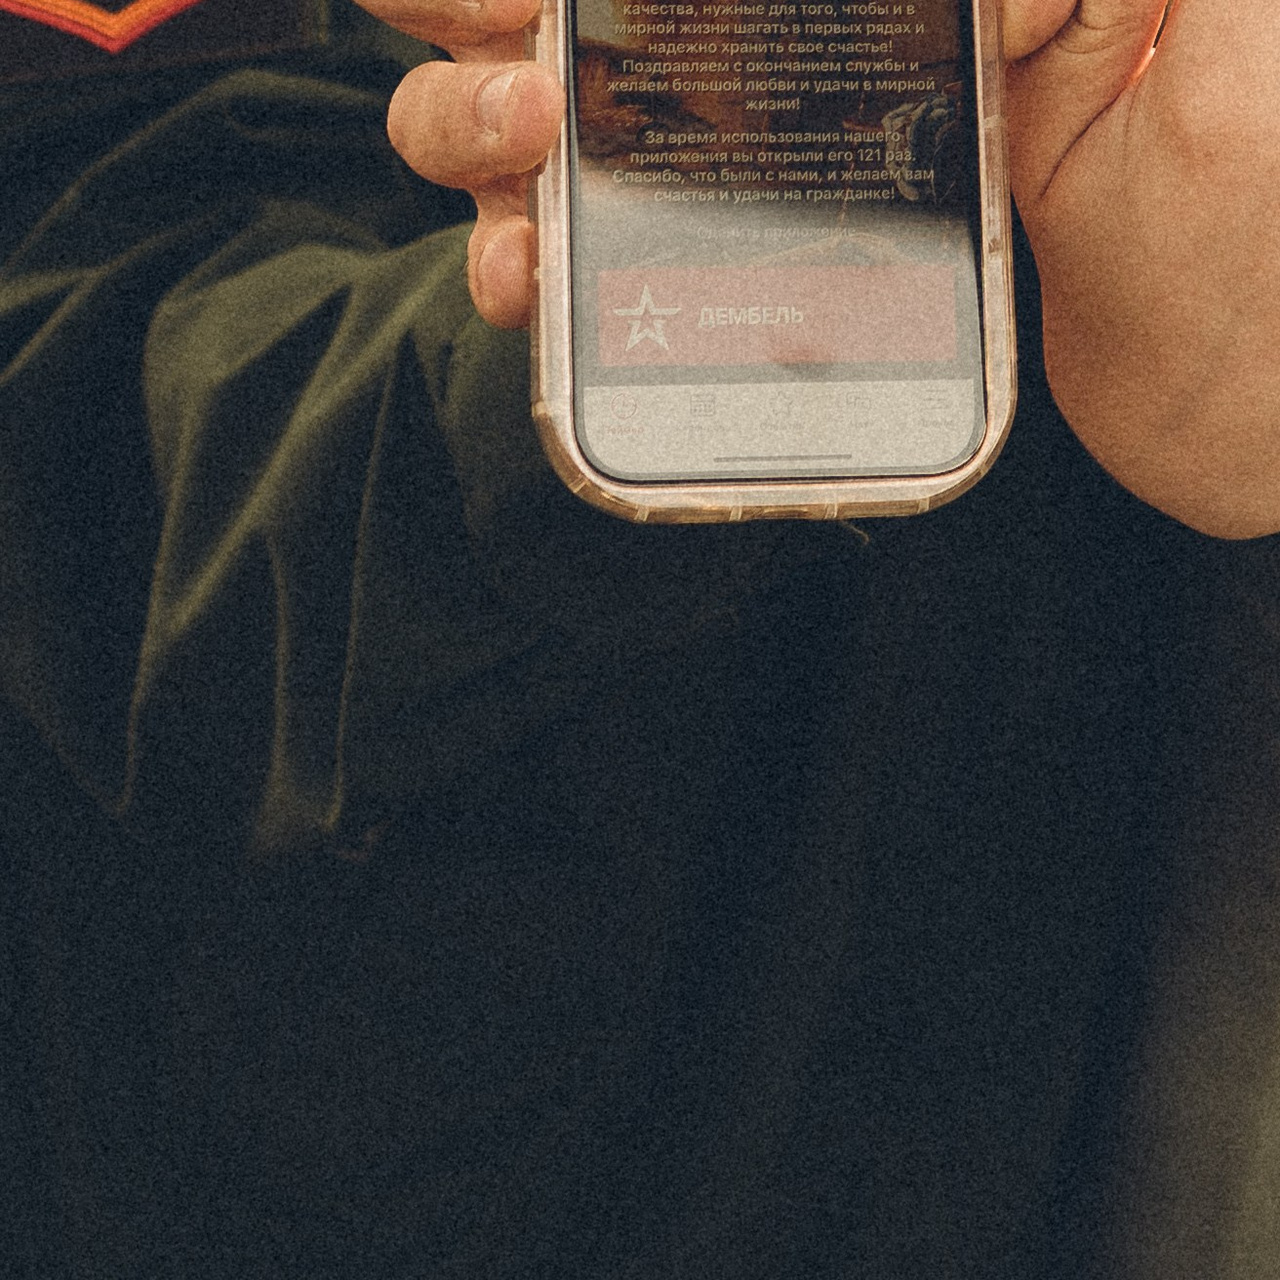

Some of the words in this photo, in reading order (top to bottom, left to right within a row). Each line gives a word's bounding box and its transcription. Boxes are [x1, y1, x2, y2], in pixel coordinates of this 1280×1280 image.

[624, 4, 698, 18] качества,
[703, 4, 763, 16] нужные
[769, 4, 795, 17] для
[802, 4, 837, 17] того,
[842, 2, 888, 15] чтобы
[894, 4, 902, 14] и
[907, 4, 915, 14] в
[615, 20, 675, 37] мирной
[680, 22, 729, 34] жизни
[734, 22, 788, 35] шагать
[793, 23, 800, 33] в
[806, 23, 861, 37] первых
[867, 23, 910, 37] рядах
[916, 23, 924, 33] и
[649, 42, 717, 56] надежно
[722, 42, 783, 54] хранить
[788, 42, 823, 53] свое
[828, 40, 893, 53] счастье!
[623, 60, 729, 75] Поздравляем
[735, 62, 742, 72] с
[747, 61, 840, 72] окончанием
[846, 58, 904, 76] службы
[910, 61, 918, 71] и
[607, 81, 668, 92] желаем
[672, 78, 741, 92] большой
[746, 78, 795, 91] любви
[801, 80, 809, 91] и
[814, 80, 859, 94] удачи
[864, 80, 872, 90] в
[877, 78, 935, 94] мирной
[746, 97, 800, 111] жизни!
[646, 131, 664, 144] За
[669, 132, 716, 147] время
[722, 131, 839, 144] использования
[845, 130, 899, 143] нашего
[631, 151, 727, 166] приложения
[733, 152, 753, 163] вы
[758, 151, 823, 165] открыли
[829, 150, 853, 161] его
[857, 149, 881, 161] 121
[886, 151, 916, 164] раз.
[613, 170, 685, 185] Спасибо,
[690, 171, 715, 182] что
[721, 168, 760, 182] были
[766, 171, 774, 181] с
[779, 170, 822, 184] нами,
[828, 170, 836, 181] и
[842, 170, 899, 181] желаем
[905, 170, 934, 180] вам
[655, 190, 715, 202] счастья
[720, 189, 728, 201] и
[733, 189, 778, 204] удачи
[784, 189, 801, 200] на
[806, 187, 895, 204] гражданке!
[700, 307, 803, 327] ДЕМБЕЛЬ
